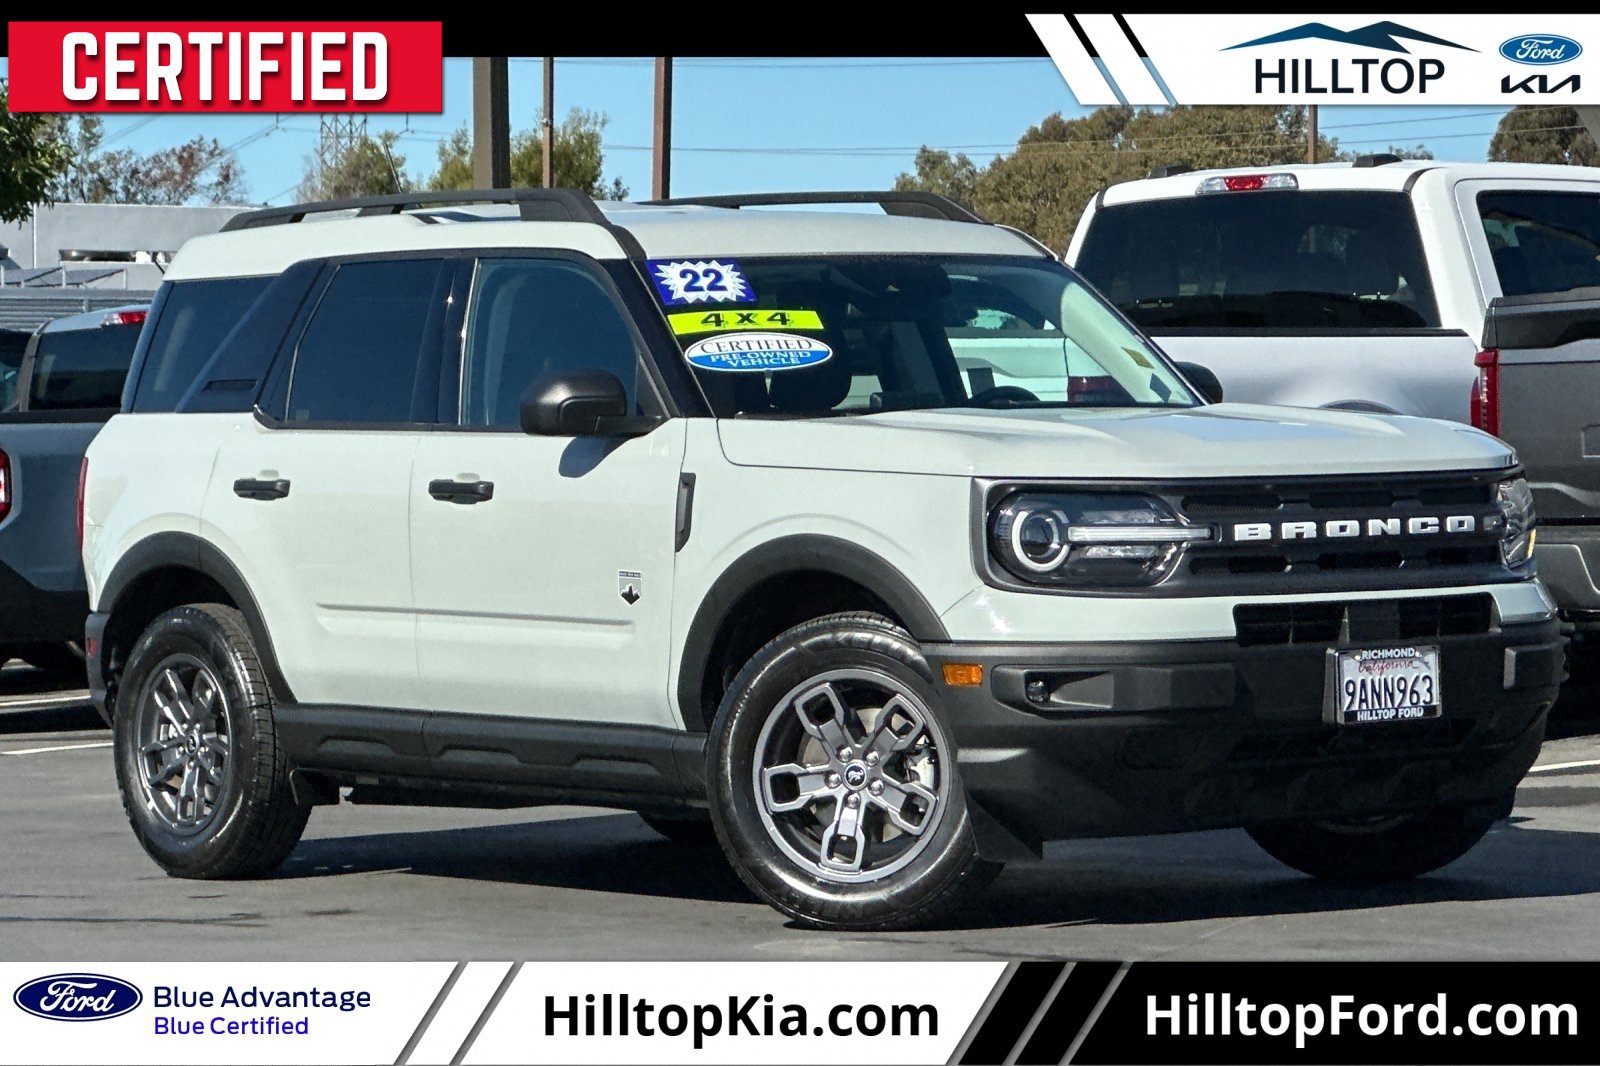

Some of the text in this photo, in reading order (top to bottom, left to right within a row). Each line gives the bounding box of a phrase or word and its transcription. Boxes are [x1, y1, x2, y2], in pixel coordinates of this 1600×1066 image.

[679, 268, 727, 292] 22
[700, 339, 813, 354] CERTIFIED
[710, 350, 812, 363] PRE-OWNED
[727, 356, 801, 367] VEHICLE
[1234, 515, 1476, 541] BRONCO
[1361, 647, 1415, 660] RICHMOND
[1358, 660, 1420, 675] California
[1345, 674, 1433, 711] 9ANN963
[1357, 707, 1424, 721] HILLTOP FORD
